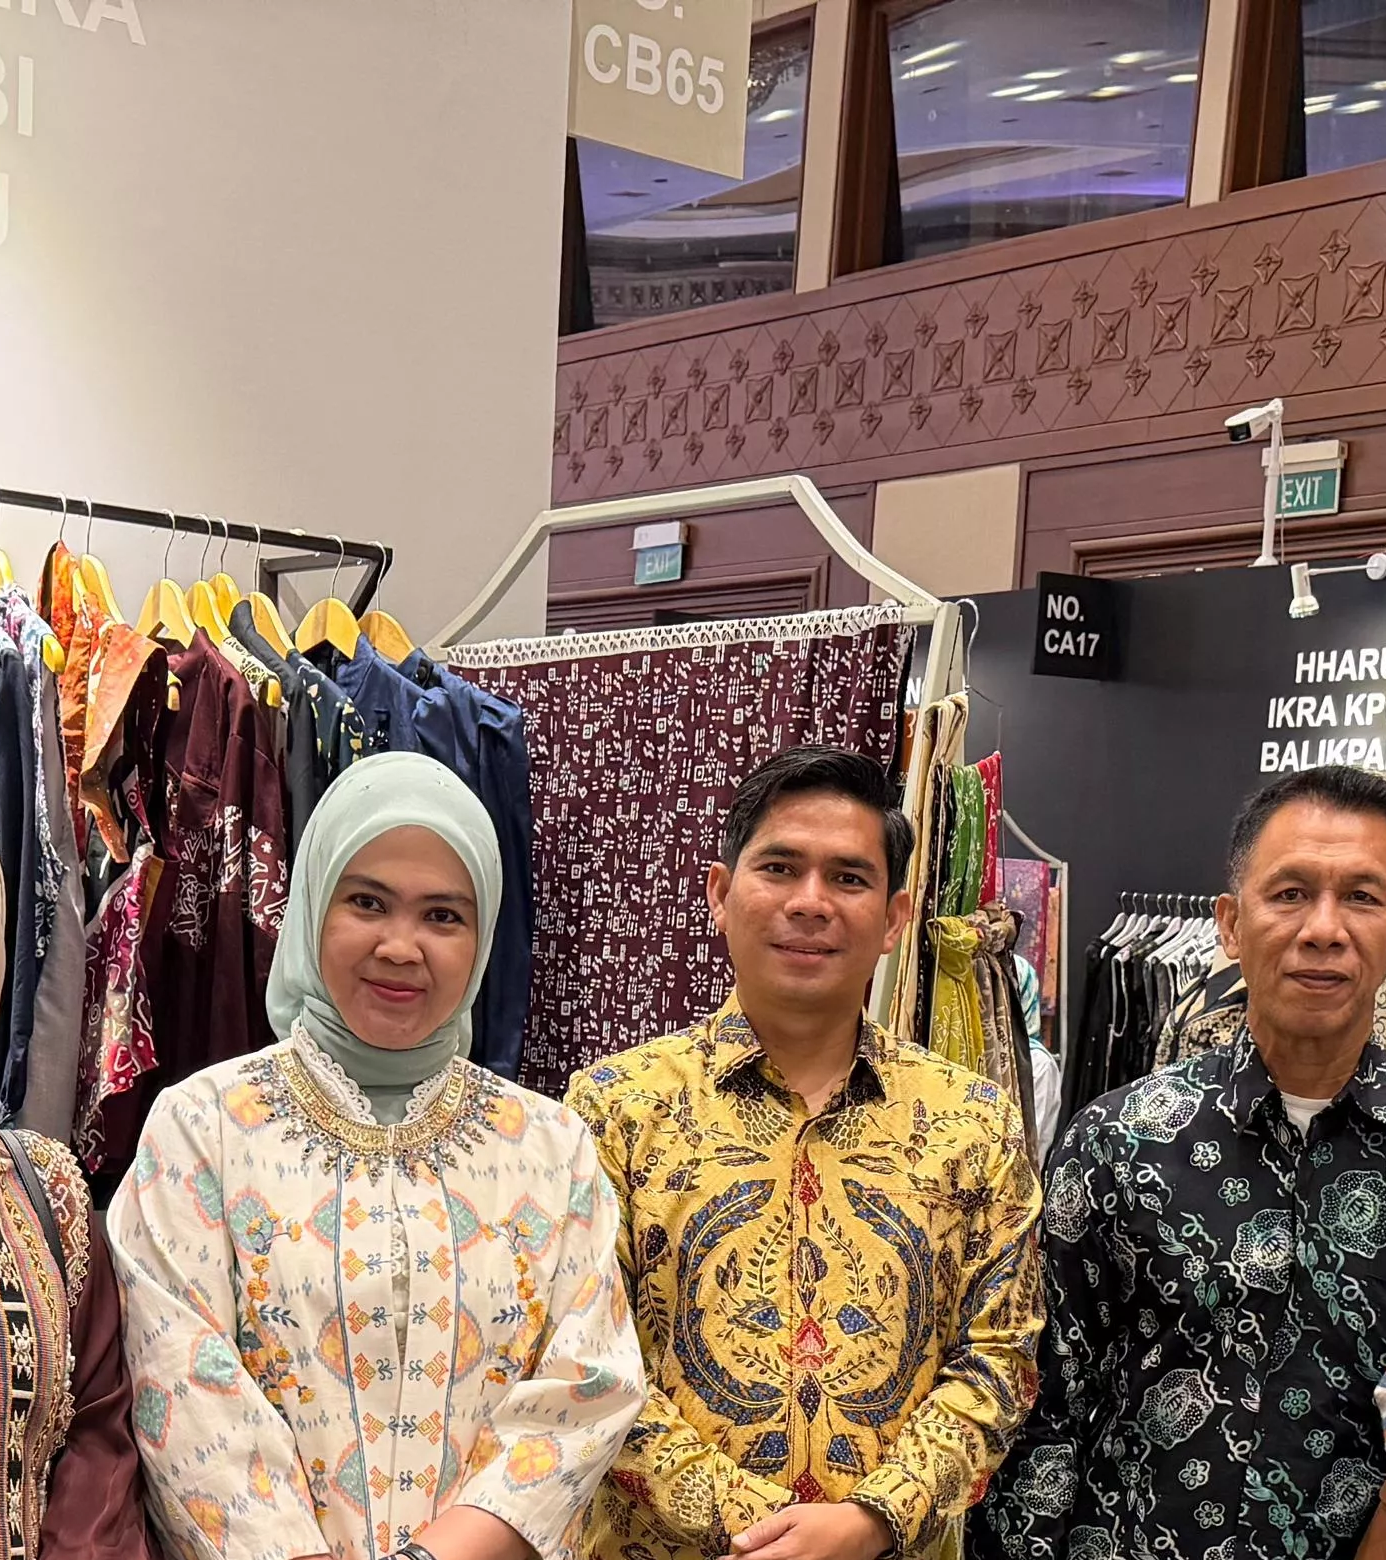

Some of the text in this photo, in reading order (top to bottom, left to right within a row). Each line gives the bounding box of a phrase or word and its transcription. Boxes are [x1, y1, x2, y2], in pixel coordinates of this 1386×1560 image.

[584, 24, 724, 114] CB65
[1281, 476, 1323, 509] EXIT
[1047, 594, 1085, 622] NO.
[1044, 629, 1100, 657] CA17
[1267, 695, 1337, 728] IKRA
